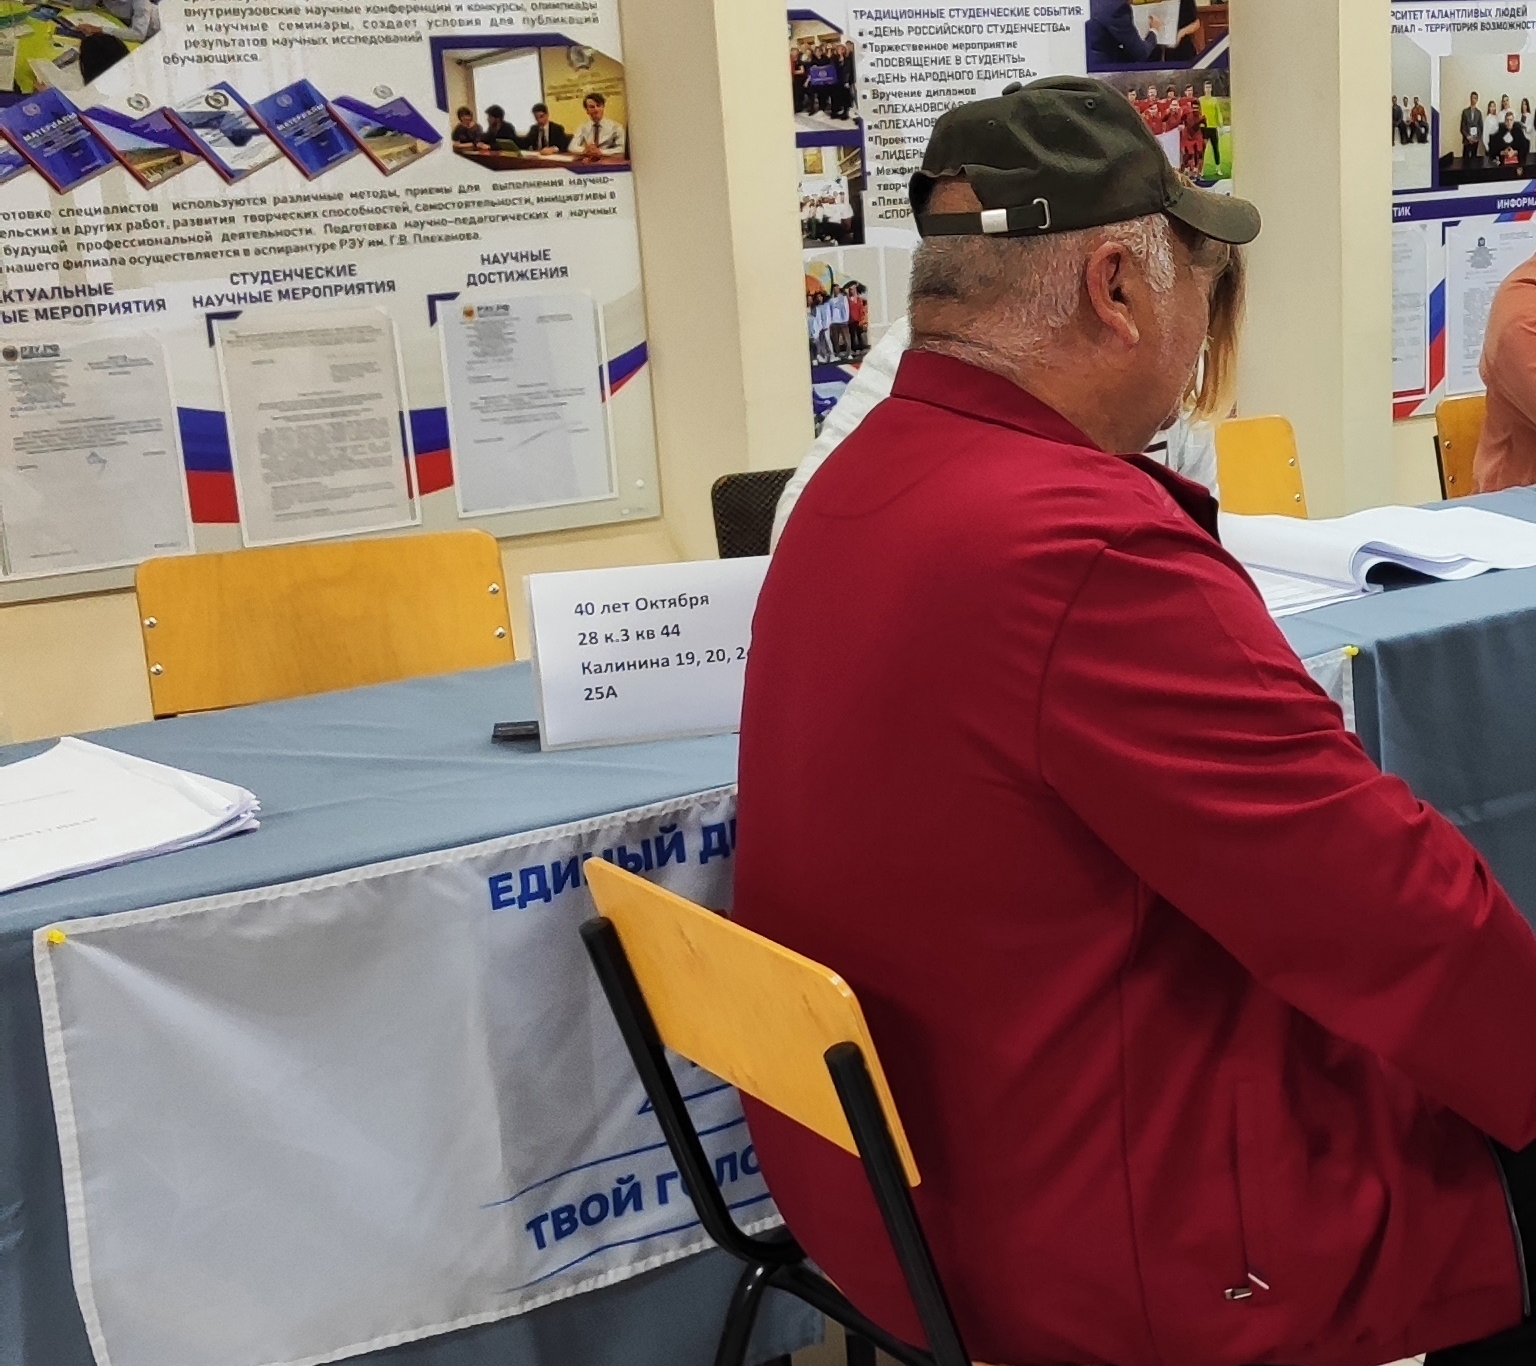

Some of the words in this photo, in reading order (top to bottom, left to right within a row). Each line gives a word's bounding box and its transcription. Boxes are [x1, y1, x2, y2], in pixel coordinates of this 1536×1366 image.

[852, 8, 946, 20] ТРАДИЦИОННЫЕ
[947, 6, 1030, 18] СТУДЕНЧЕСКИЕ
[1424, 8, 1493, 19] ТАЛАНТЛИВЫХ
[1494, 5, 1528, 18] ЛЮДЕЙ
[868, 25, 905, 37] «ДЕНЬ
[906, 22, 984, 35] РОССИЙСКОГО
[985, 22, 1070, 34] СТУДЕНЧЕСТВА»
[1424, 21, 1479, 32] ТЕРРИТОРИЯ
[869, 42, 949, 53] Торжественное
[951, 41, 1018, 51] мероприятие
[868, 55, 952, 67] «ПОСВЯЩЕНИЕ
[954, 54, 962, 65] В
[963, 53, 1026, 65] СТУДЕНТЫ»
[867, 72, 907, 84] «ДЕНЬ
[909, 70, 974, 82] НАРОДНОГО
[975, 68, 1037, 80] ЕДИНСТВА»
[870, 88, 922, 101] Вручение
[924, 87, 976, 97] дипломов
[479, 248, 551, 265] НАУЧНЫЕ
[228, 263, 357, 285] СТУДЕНЧЕСКИЕ
[465, 266, 569, 286] ДОСТИЖЕНИЯ
[0, 282, 114, 303] КТУАЛЬНЫЕ
[191, 289, 273, 307] НАУЧНЫЕ
[276, 280, 396, 300] МЕРОПРИЯТИЯ
[33, 298, 166, 320] МЕРОПРИЯТИЯ
[574, 602, 595, 616] 40
[600, 602, 630, 615] лет
[635, 593, 710, 611] Октября
[578, 632, 598, 646] 28
[636, 629, 655, 640] кв
[660, 624, 681, 637] 44
[581, 657, 670, 675] Калинина
[676, 651, 701, 667] 19,
[705, 648, 731, 664] 20,
[584, 685, 618, 701] 25А
[525, 1174, 645, 1251] ТВОЙ
